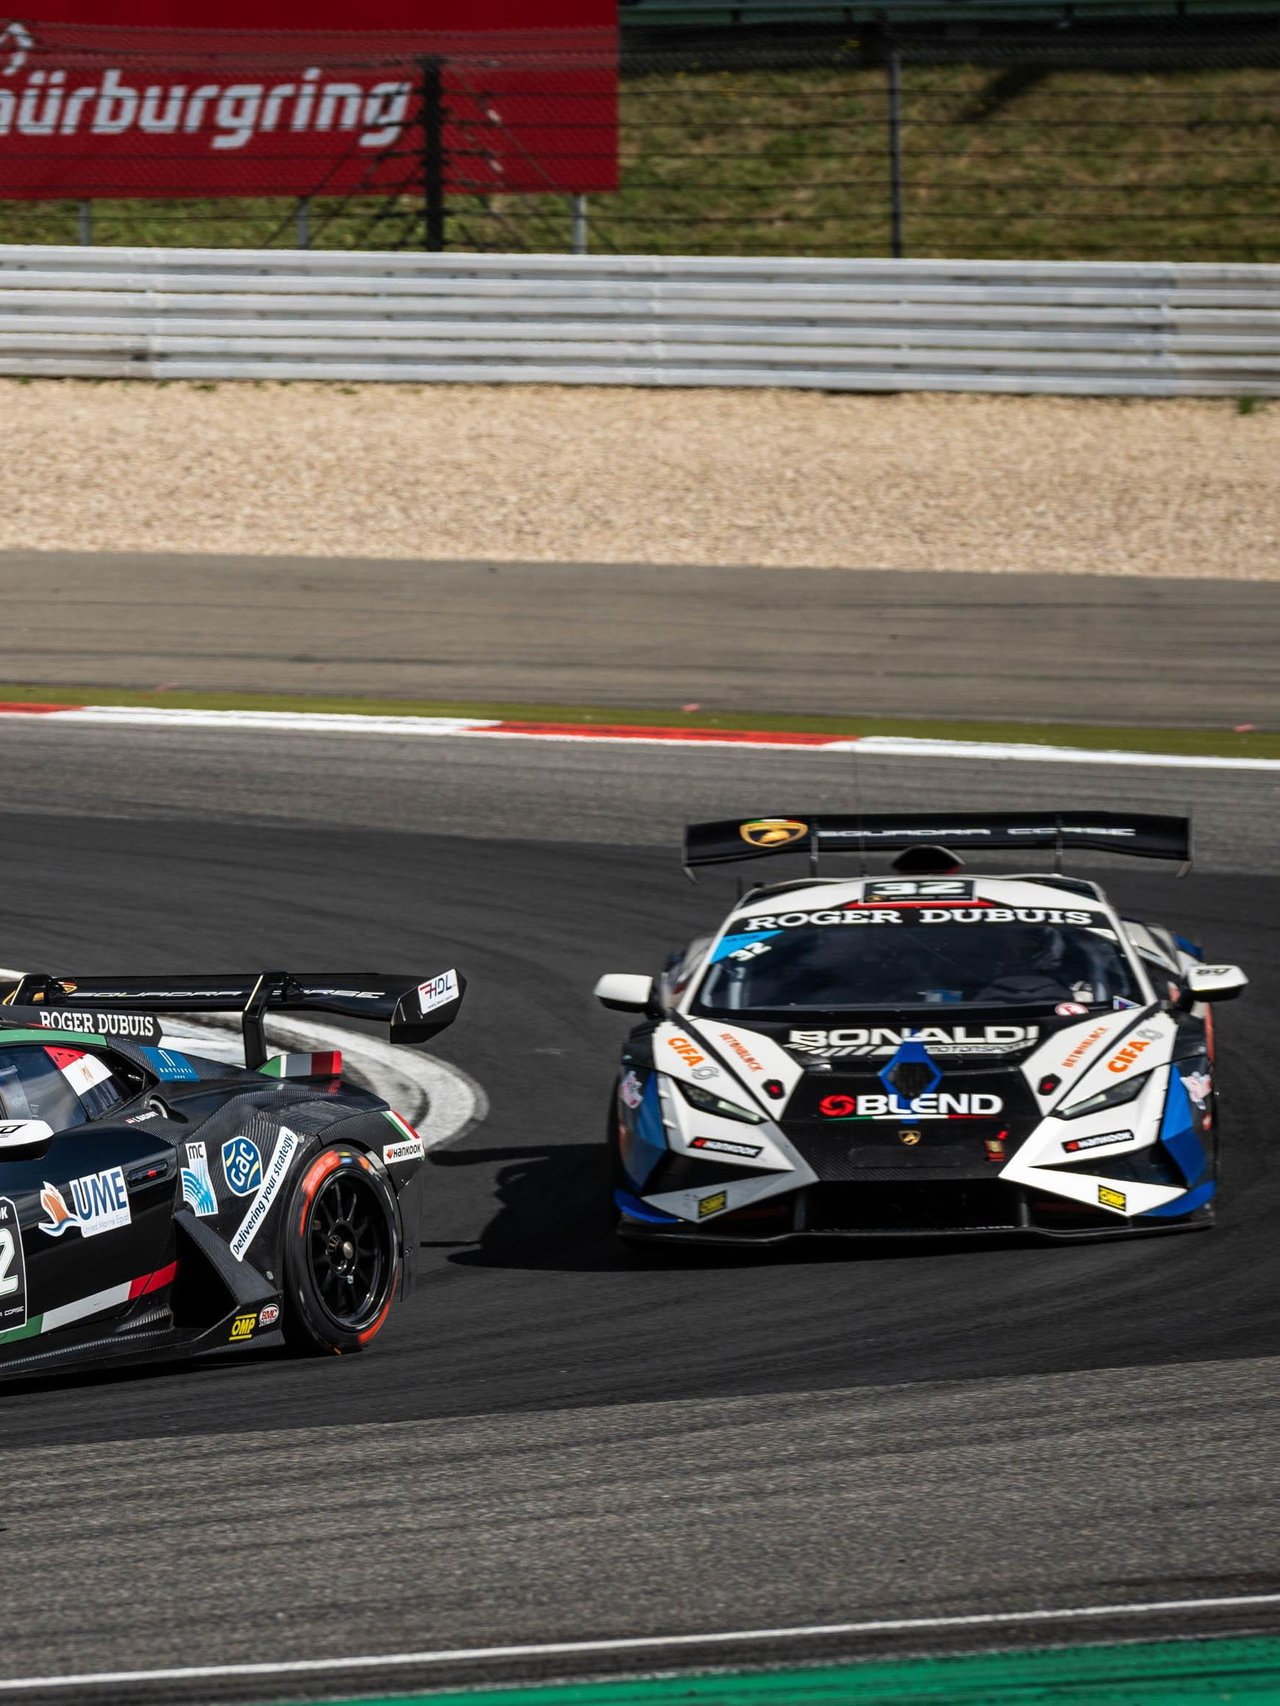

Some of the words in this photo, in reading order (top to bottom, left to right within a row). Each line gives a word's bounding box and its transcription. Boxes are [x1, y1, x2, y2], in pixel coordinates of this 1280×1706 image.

[871, 880, 966, 895] 32
[744, 909, 903, 931] ROGER
[919, 908, 1093, 925] DUBUIS
[728, 942, 772, 961] 32
[40, 1011, 95, 1033] ROGER
[97, 1013, 154, 1037] DUBUIS
[667, 1037, 705, 1067] CIFA
[1107, 1040, 1151, 1073] CIFA
[856, 1093, 1004, 1116] BLEND
[72, 1171, 128, 1221] UME
[232, 1201, 266, 1255] Delivering
[262, 1174, 278, 1203] your
[273, 1134, 295, 1176] strategy.
[231, 1317, 256, 1336] OMP
